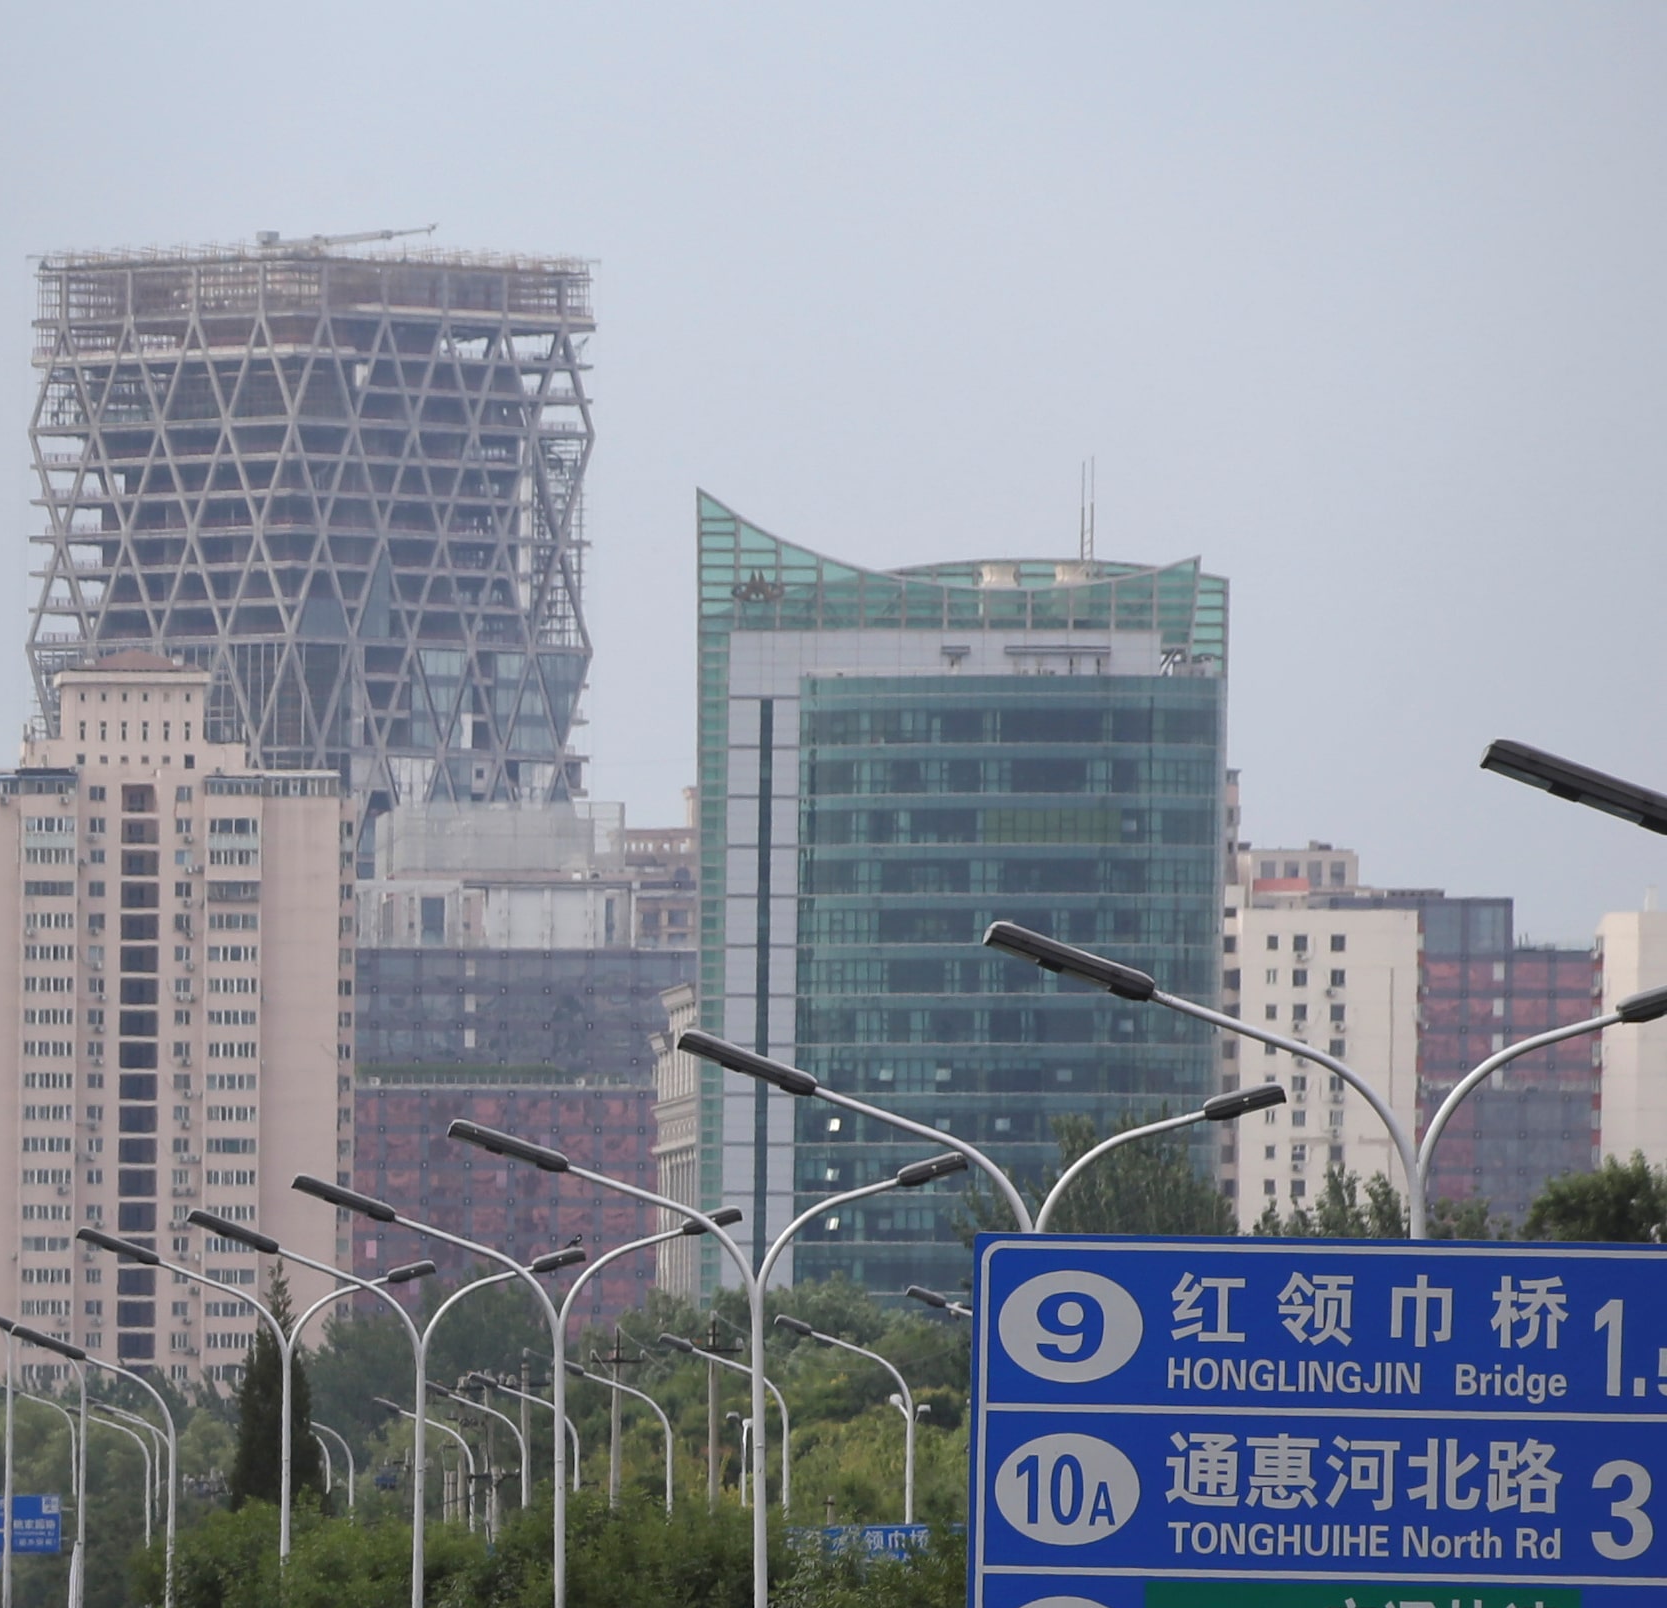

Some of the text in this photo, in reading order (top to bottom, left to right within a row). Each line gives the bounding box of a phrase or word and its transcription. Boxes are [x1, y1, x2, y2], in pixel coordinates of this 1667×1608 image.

[1036, 1292, 1105, 1363] 9
[1170, 1272, 1569, 1350] 红领巾桥
[1166, 1357, 1568, 1404] HONGLINGJIN Bridge
[1014, 1453, 1116, 1528] 10A
[1164, 1431, 1653, 1561] 通惠河北路 3
[1167, 1521, 1563, 1560] TONGHUIHE North Rd
